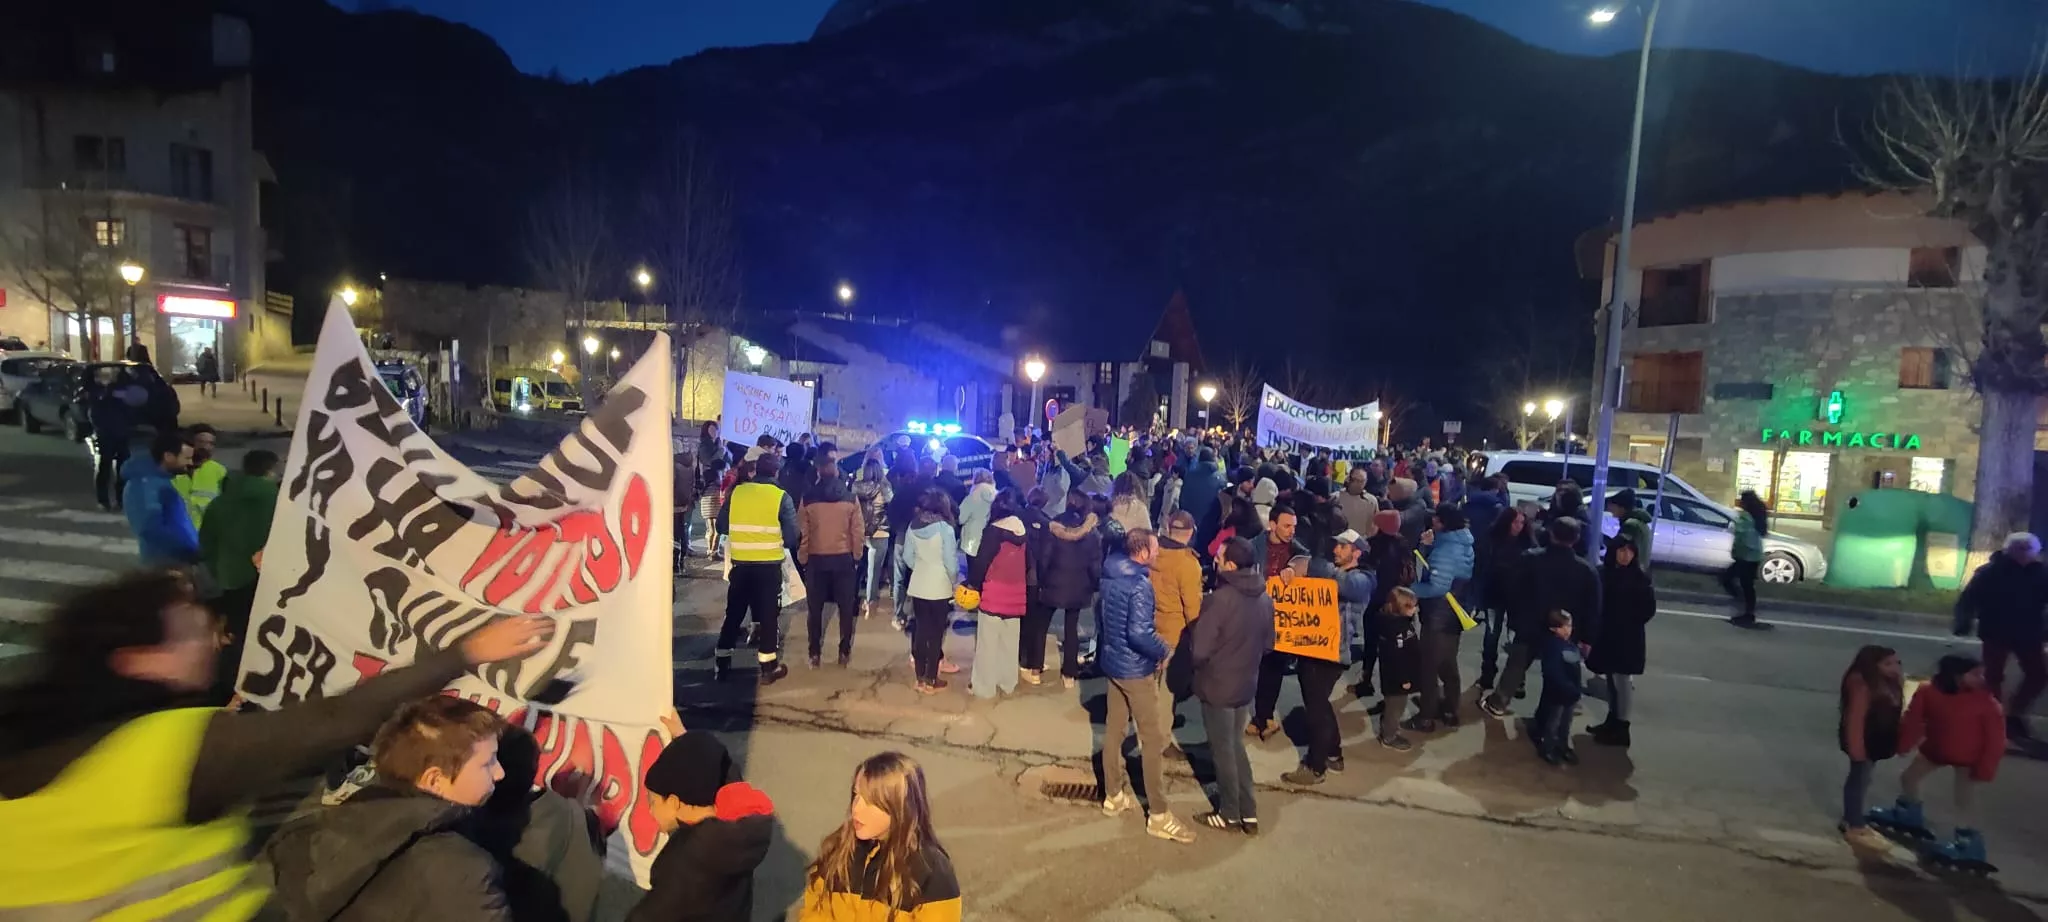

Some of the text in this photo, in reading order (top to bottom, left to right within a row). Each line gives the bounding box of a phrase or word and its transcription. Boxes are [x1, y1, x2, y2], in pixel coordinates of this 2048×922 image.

[776, 391, 790, 409] HA
[1350, 407, 1370, 421] DE
[734, 416, 758, 436] LOS
[1762, 428, 1922, 449] FARMACIA
[1272, 583, 1332, 607] ALGUIEN HA
[1274, 609, 1320, 628] PENSADO
